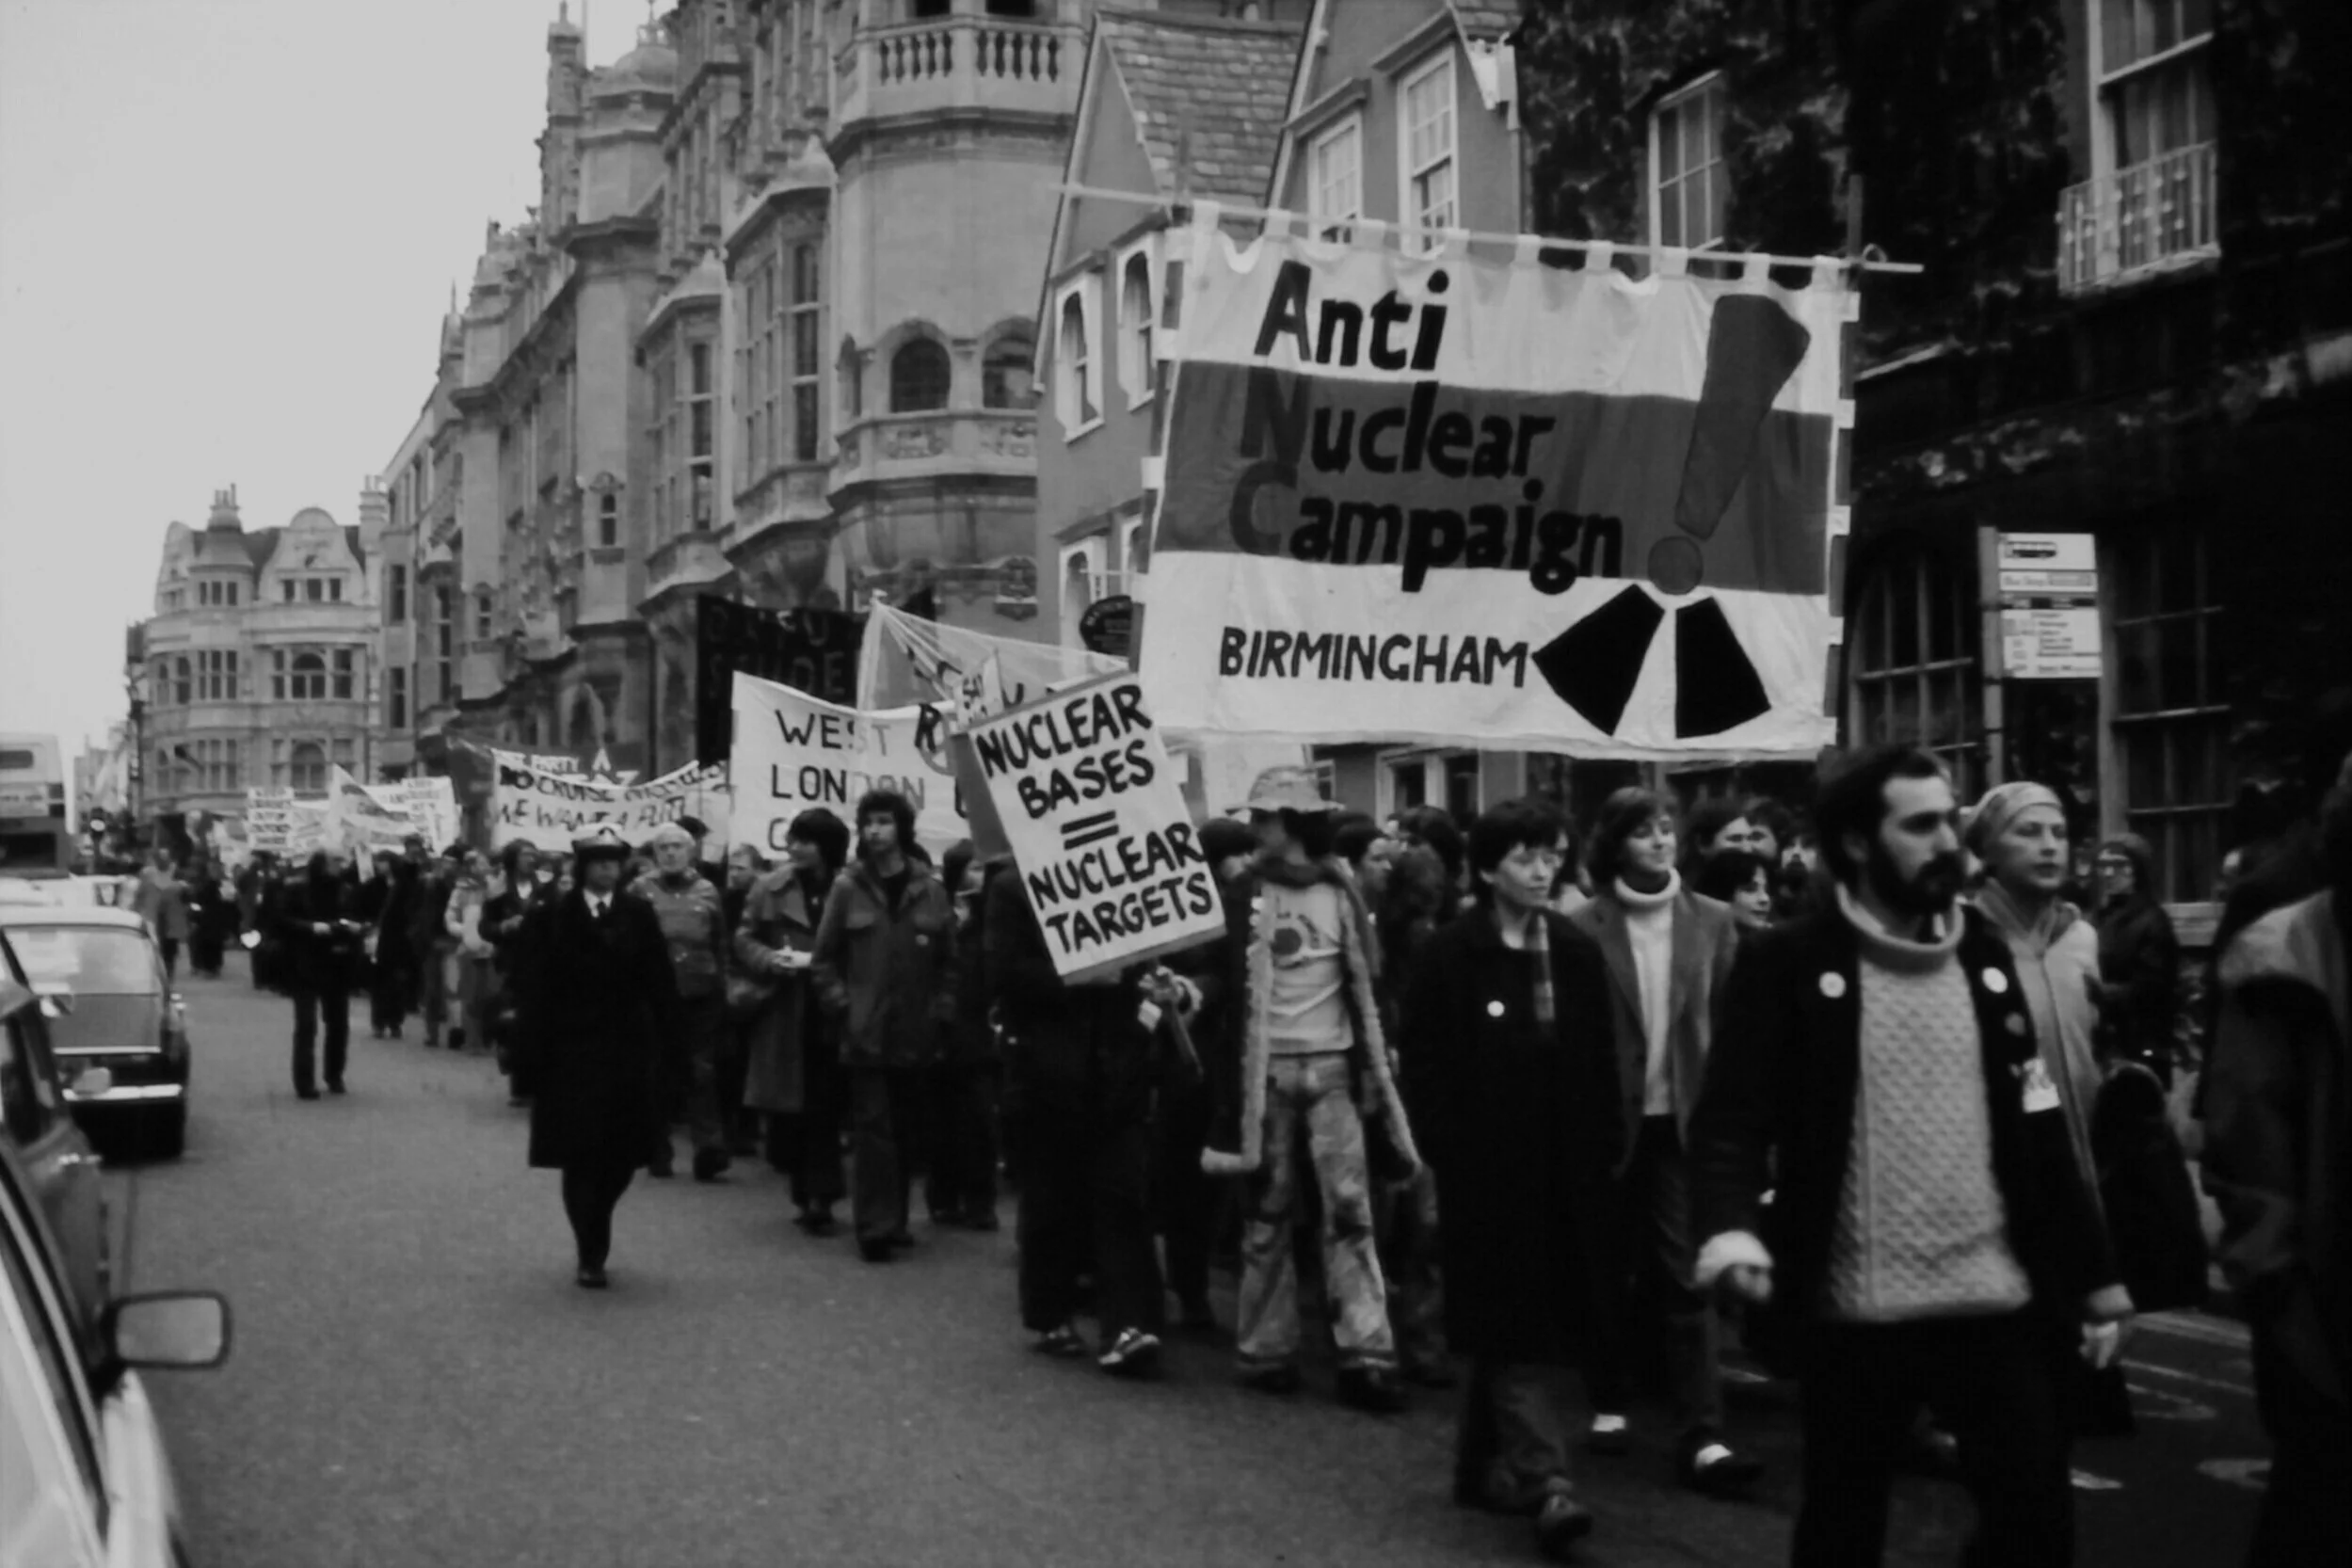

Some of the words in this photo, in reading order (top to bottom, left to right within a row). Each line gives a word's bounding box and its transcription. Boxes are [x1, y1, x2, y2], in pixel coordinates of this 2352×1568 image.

[1254, 259, 1449, 371] Anti
[1240, 367, 1557, 478] Nuclear
[1229, 460, 1623, 596] Campaign
[1218, 626, 1528, 688] BIRMINGHAM
[775, 709, 890, 756] WEST
[975, 684, 1153, 778] NUCLEAR
[1017, 739, 1155, 819] BASES
[1028, 822, 1207, 910] NUCLEAR
[1046, 872, 1213, 953] TARGETS
